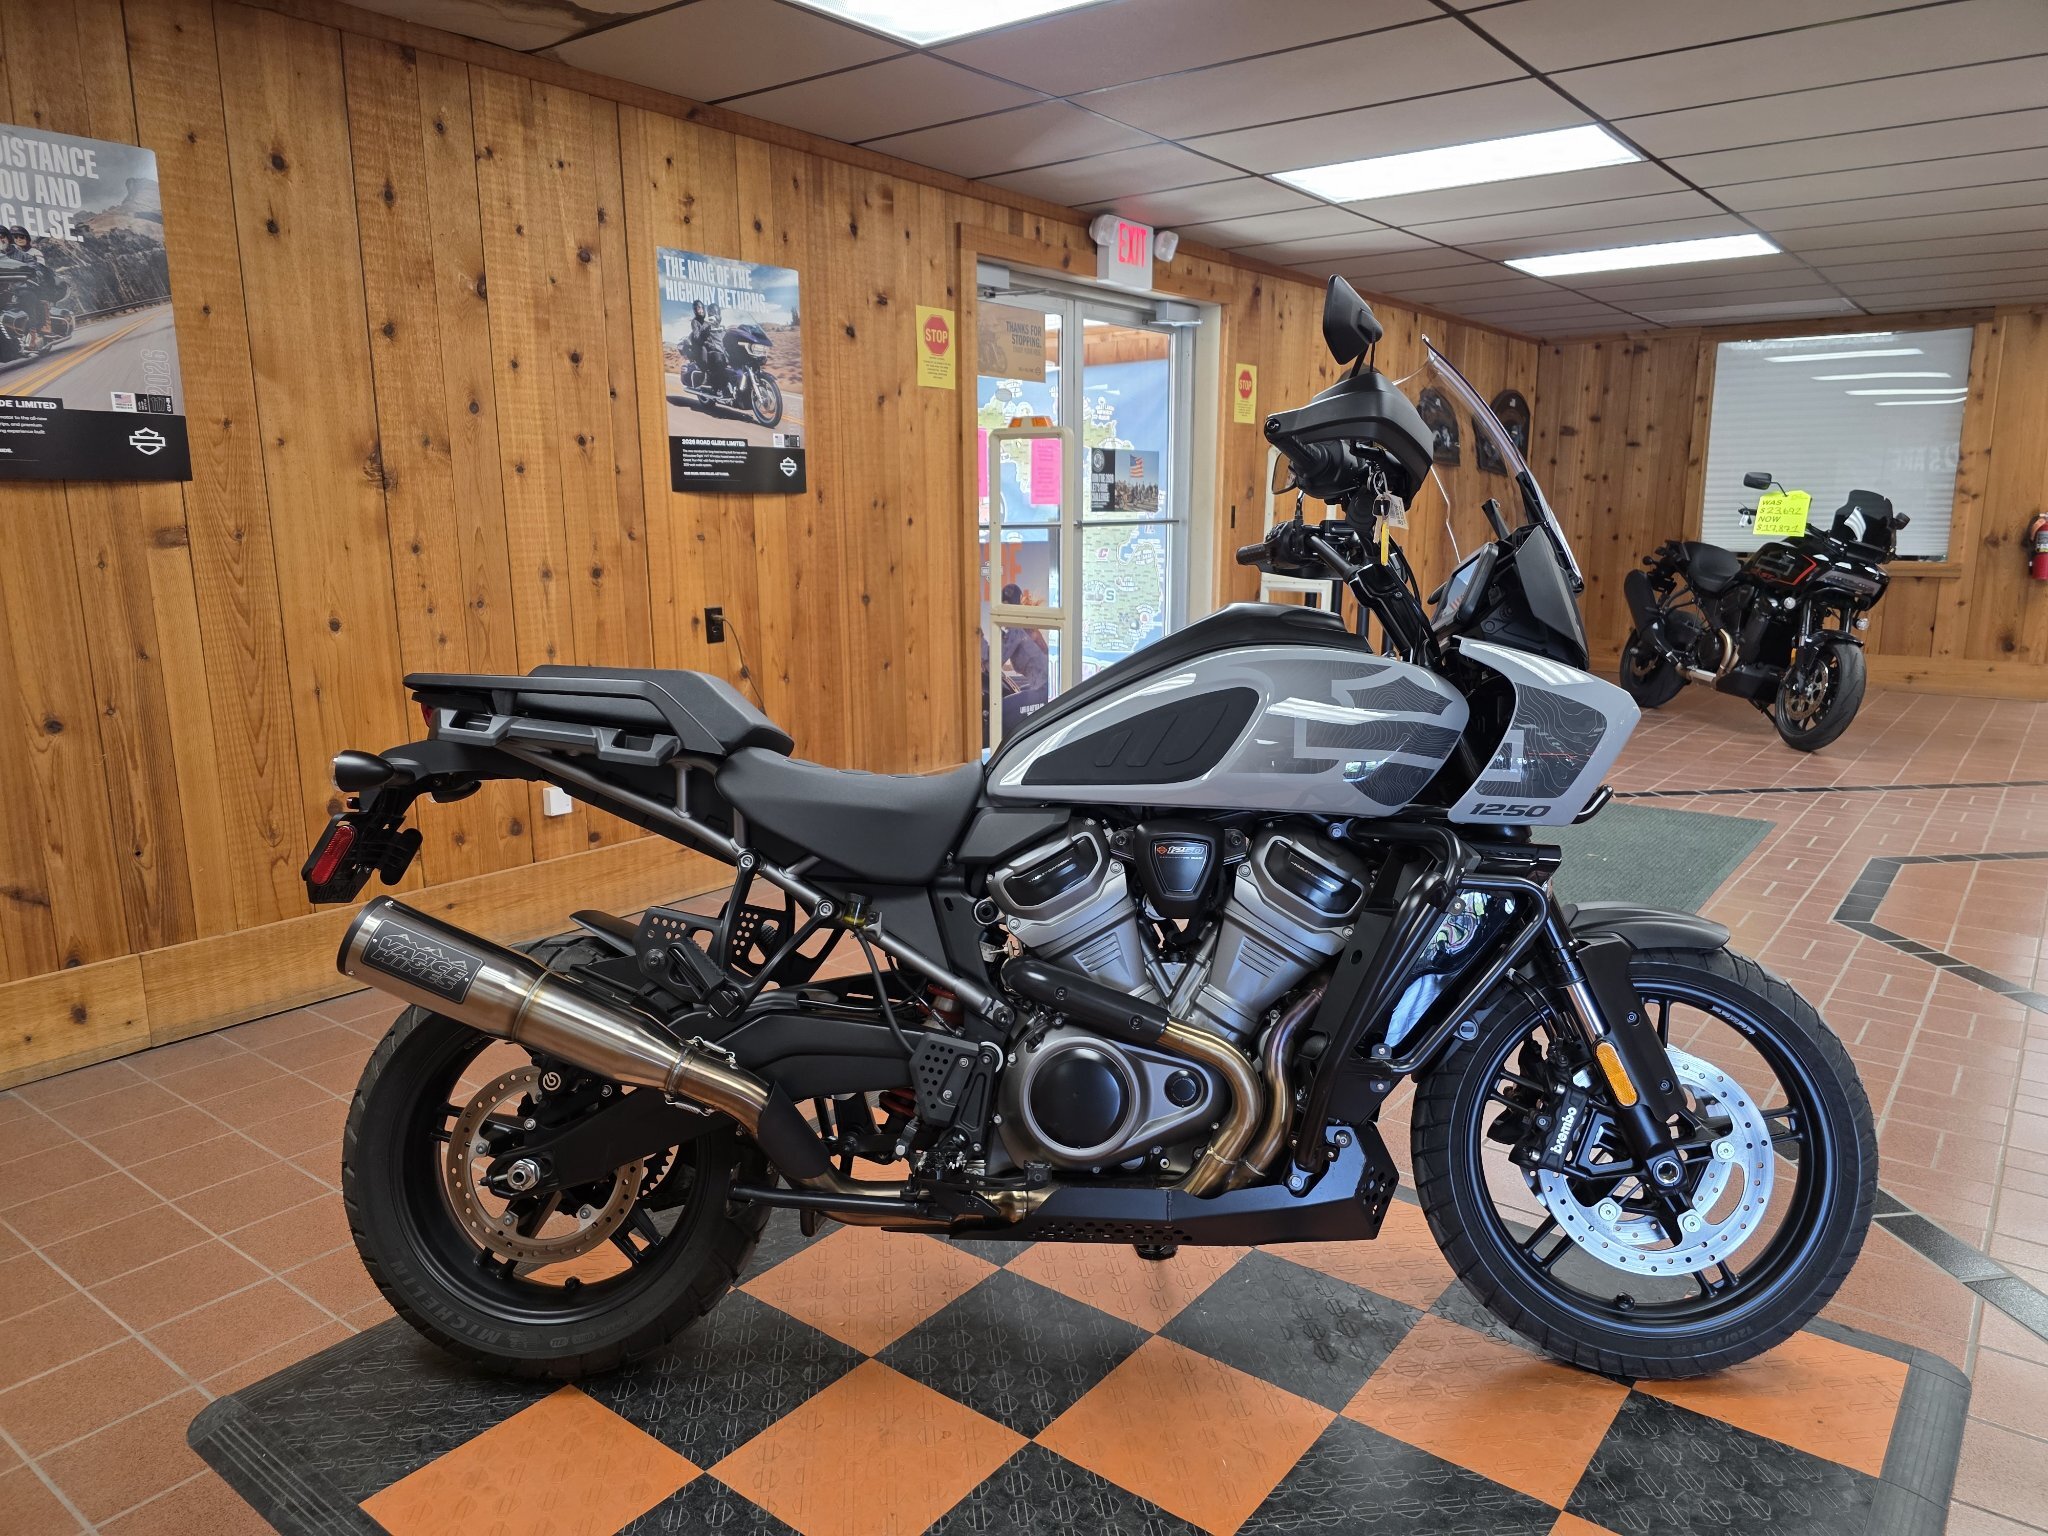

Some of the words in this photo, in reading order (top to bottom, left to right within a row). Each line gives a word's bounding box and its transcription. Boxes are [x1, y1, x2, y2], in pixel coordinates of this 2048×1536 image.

[0, 134, 99, 180] ISTANCE
[35, 174, 82, 209] AND
[21, 205, 84, 243] ELSE.
[1118, 221, 1147, 269] EXIT
[663, 255, 687, 280] THE
[687, 259, 715, 286] KING
[716, 264, 730, 288] OF
[731, 267, 753, 290] THE
[665, 279, 716, 306] HIGHWAY
[925, 328, 948, 344] STOP
[1006, 321, 1029, 335] THANKS
[1030, 324, 1042, 337] FOR
[1011, 334, 1042, 349] STOPPING.
[1239, 379, 1252, 391] STOP
[15, 400, 57, 410] LIMITED
[1469, 802, 1552, 818] 1250
[1167, 845, 1205, 855] 1250
[370, 948, 456, 991] HINES
[377, 934, 469, 983] VANCE
[1550, 1107, 1577, 1154] brembo
[390, 1261, 502, 1344] MICHELIN
